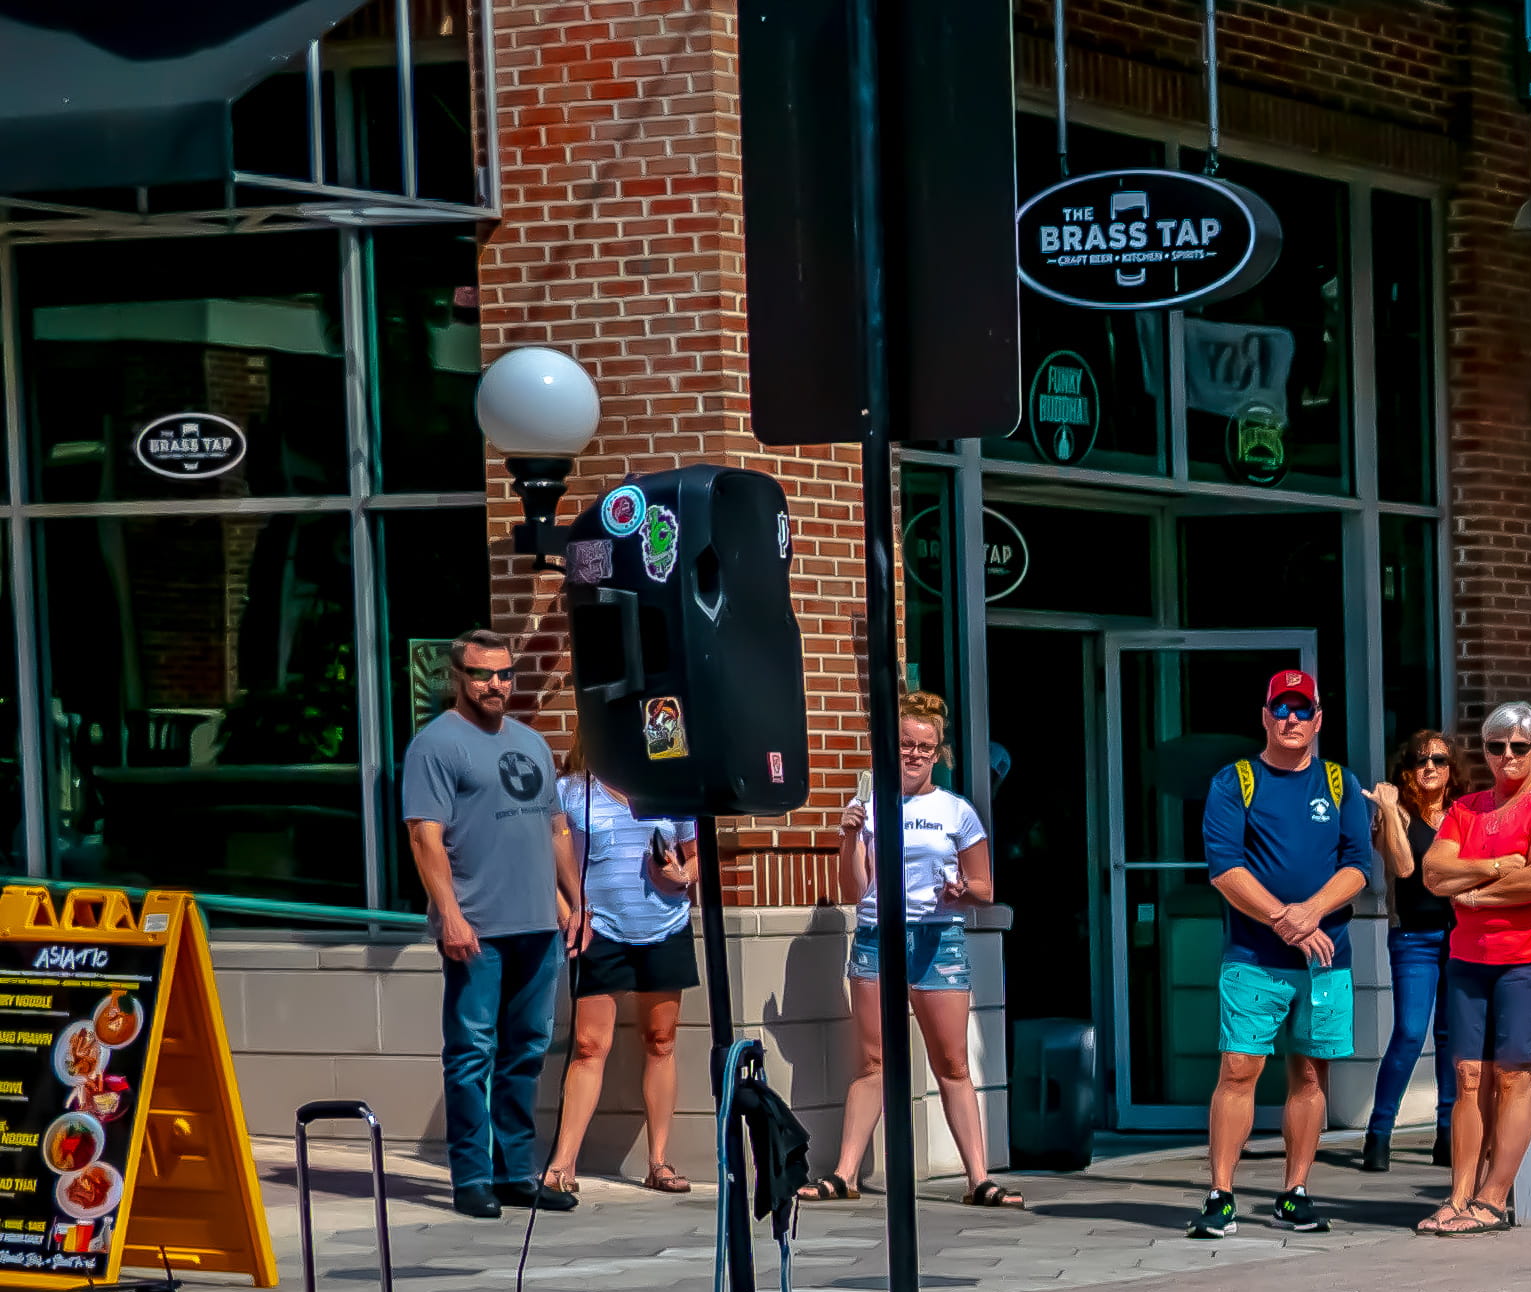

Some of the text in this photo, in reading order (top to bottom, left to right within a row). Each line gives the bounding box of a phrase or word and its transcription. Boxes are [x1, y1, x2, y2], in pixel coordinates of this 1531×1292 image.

[1063, 206, 1094, 222] THE
[1040, 217, 1221, 253] BRASS TAP
[1058, 255, 1087, 266] CRAFT
[1121, 251, 1163, 263] KITCHEN
[1171, 249, 1204, 261] SPIRITS
[150, 437, 233, 453] BRASS TAP
